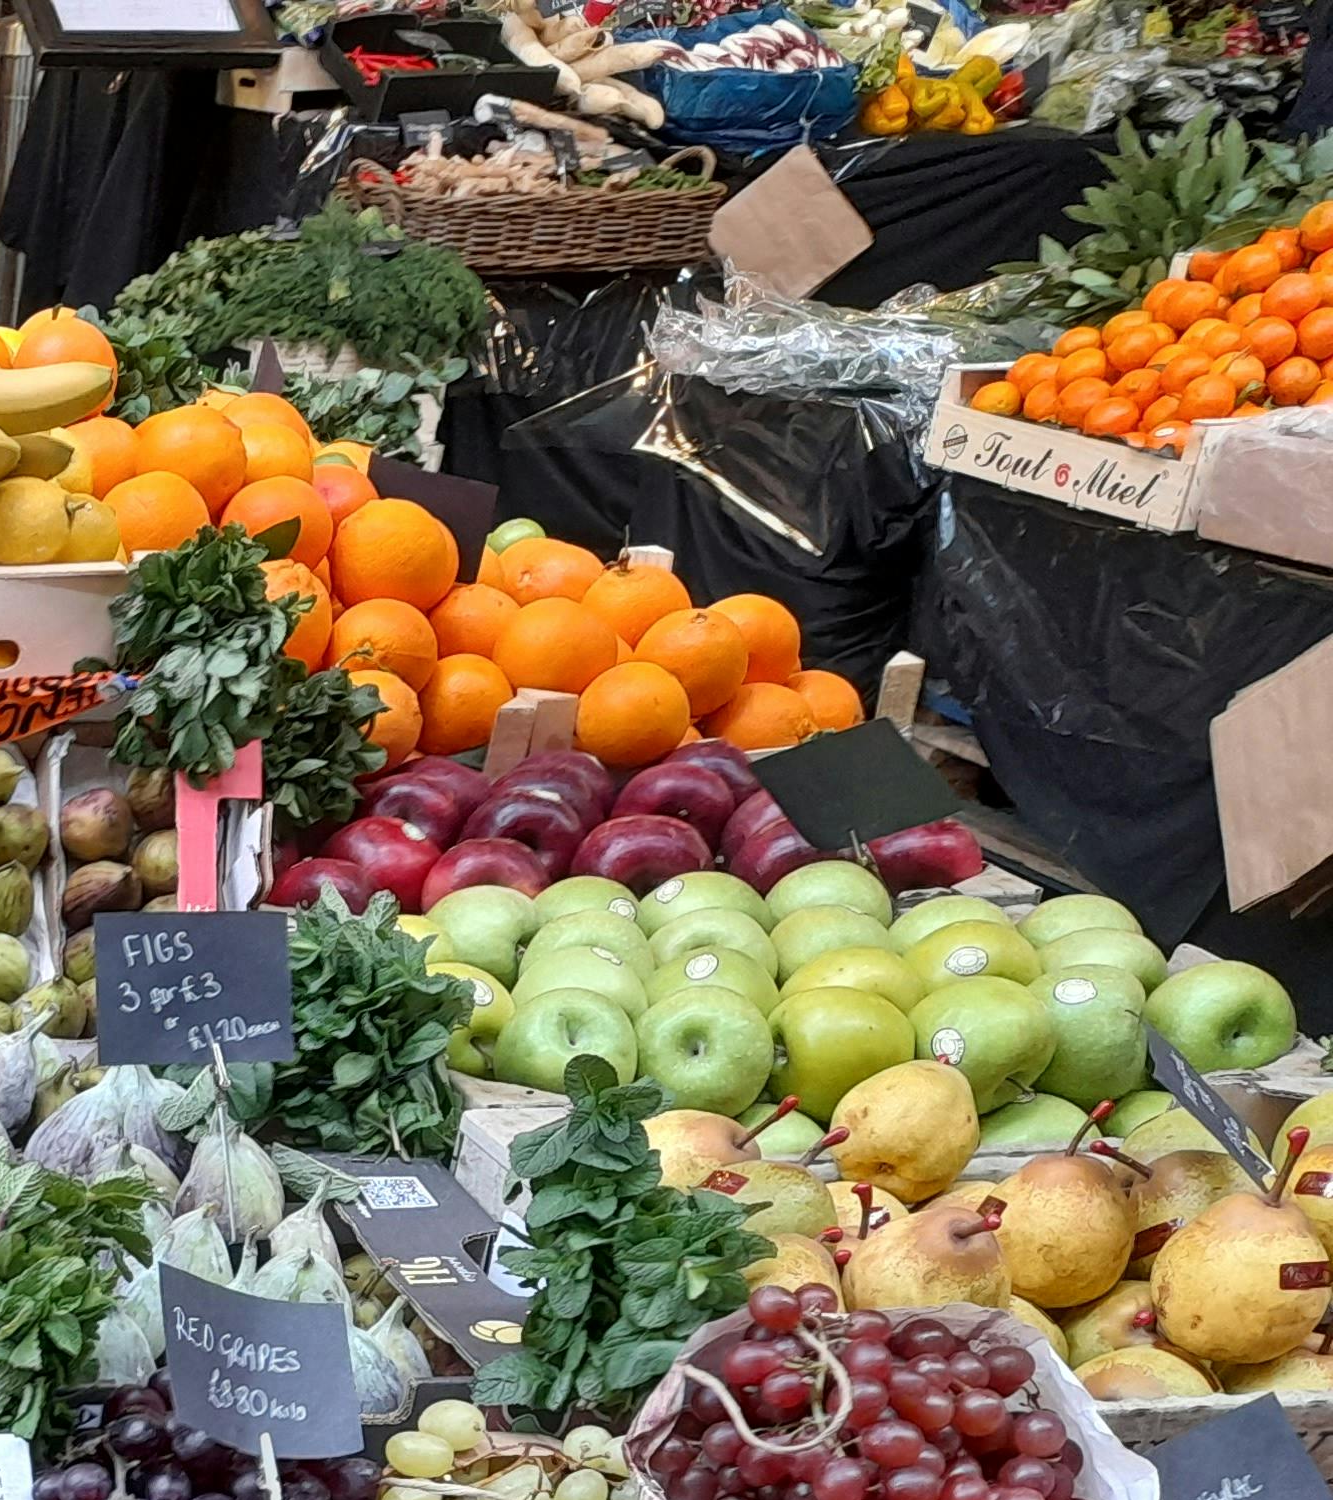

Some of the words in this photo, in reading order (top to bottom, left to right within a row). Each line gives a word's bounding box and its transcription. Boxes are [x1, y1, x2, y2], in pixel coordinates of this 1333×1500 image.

[974, 432, 1053, 480] Tout
[1072, 459, 1162, 508] Miel
[122, 931, 194, 968] FIGS
[118, 981, 141, 1012] 3
[173, 1306, 215, 1353] RED
[219, 1333, 302, 1374] GRAPES
